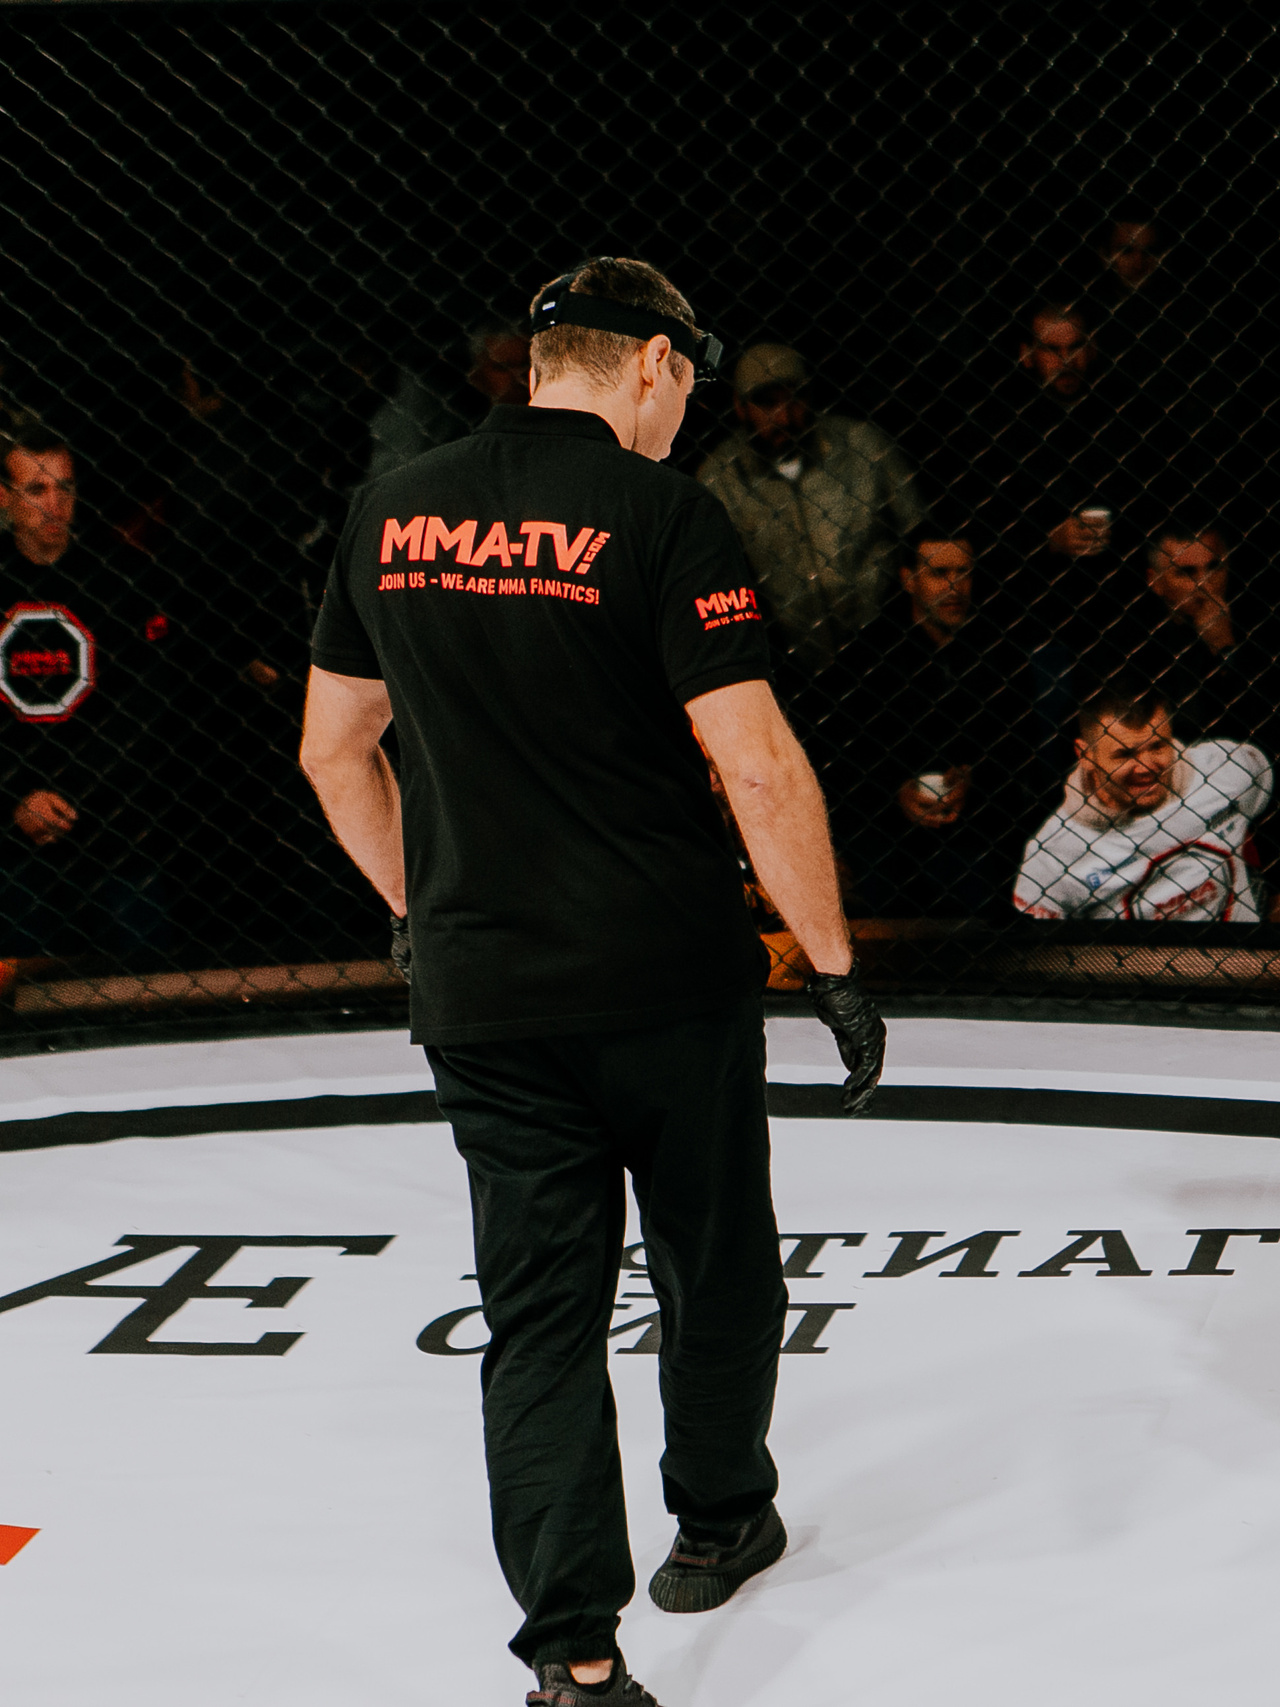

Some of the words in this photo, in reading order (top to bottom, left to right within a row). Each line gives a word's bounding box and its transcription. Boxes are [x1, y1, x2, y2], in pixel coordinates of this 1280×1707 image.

[378, 572, 405, 591] JOIN
[409, 572, 426, 588] US
[441, 572, 464, 590] WE
[465, 576, 495, 595] ARE
[498, 577, 527, 595] MMA
[530, 577, 600, 606] FANATICS!
